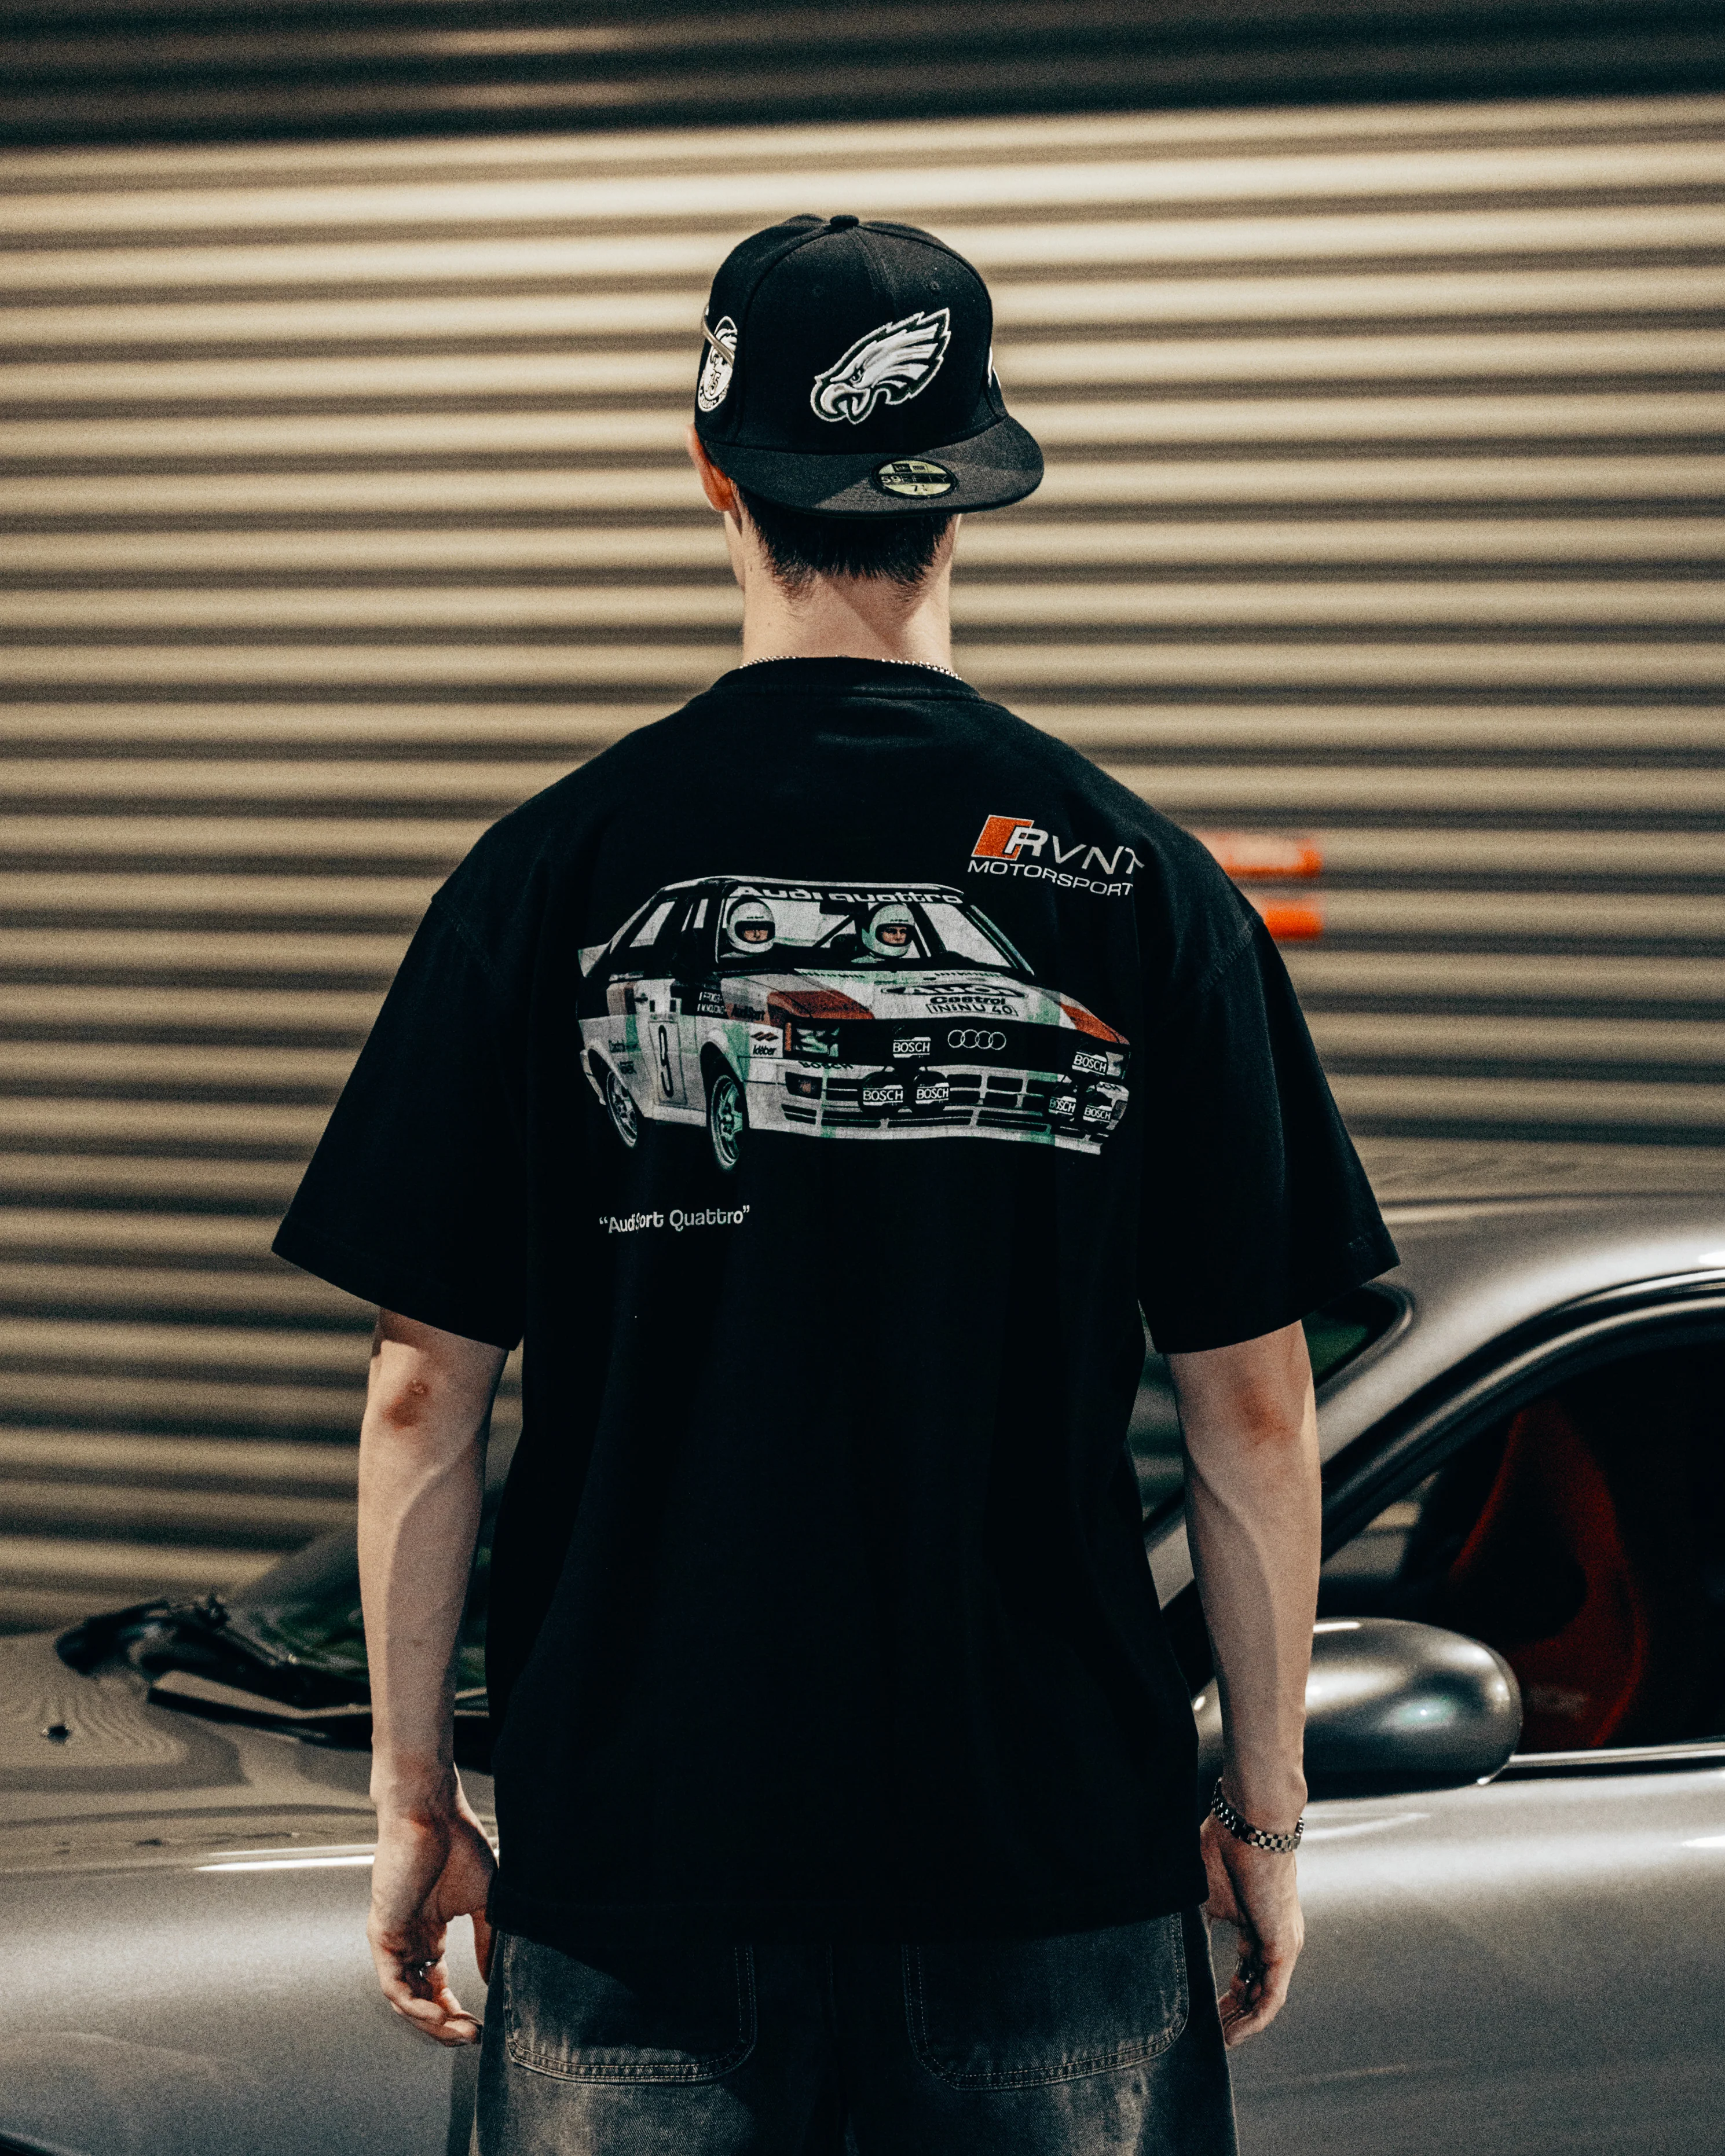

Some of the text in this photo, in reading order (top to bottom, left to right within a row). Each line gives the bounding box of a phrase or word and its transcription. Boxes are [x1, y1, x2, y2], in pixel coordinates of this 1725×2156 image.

[967, 860, 1133, 896] MOTORSPORT
[828, 889, 963, 904] quattro
[930, 996, 1006, 1005] Castrol
[892, 1042, 931, 1053] BOSCH
[658, 1024, 674, 1098] 9
[1073, 1054, 1107, 1073] BOSCH
[863, 1089, 903, 1101] BOSCH
[916, 1087, 950, 1099] BOSCH
[1049, 1098, 1076, 1113] BOSCH
[1083, 1106, 1112, 1121] BOSCH
